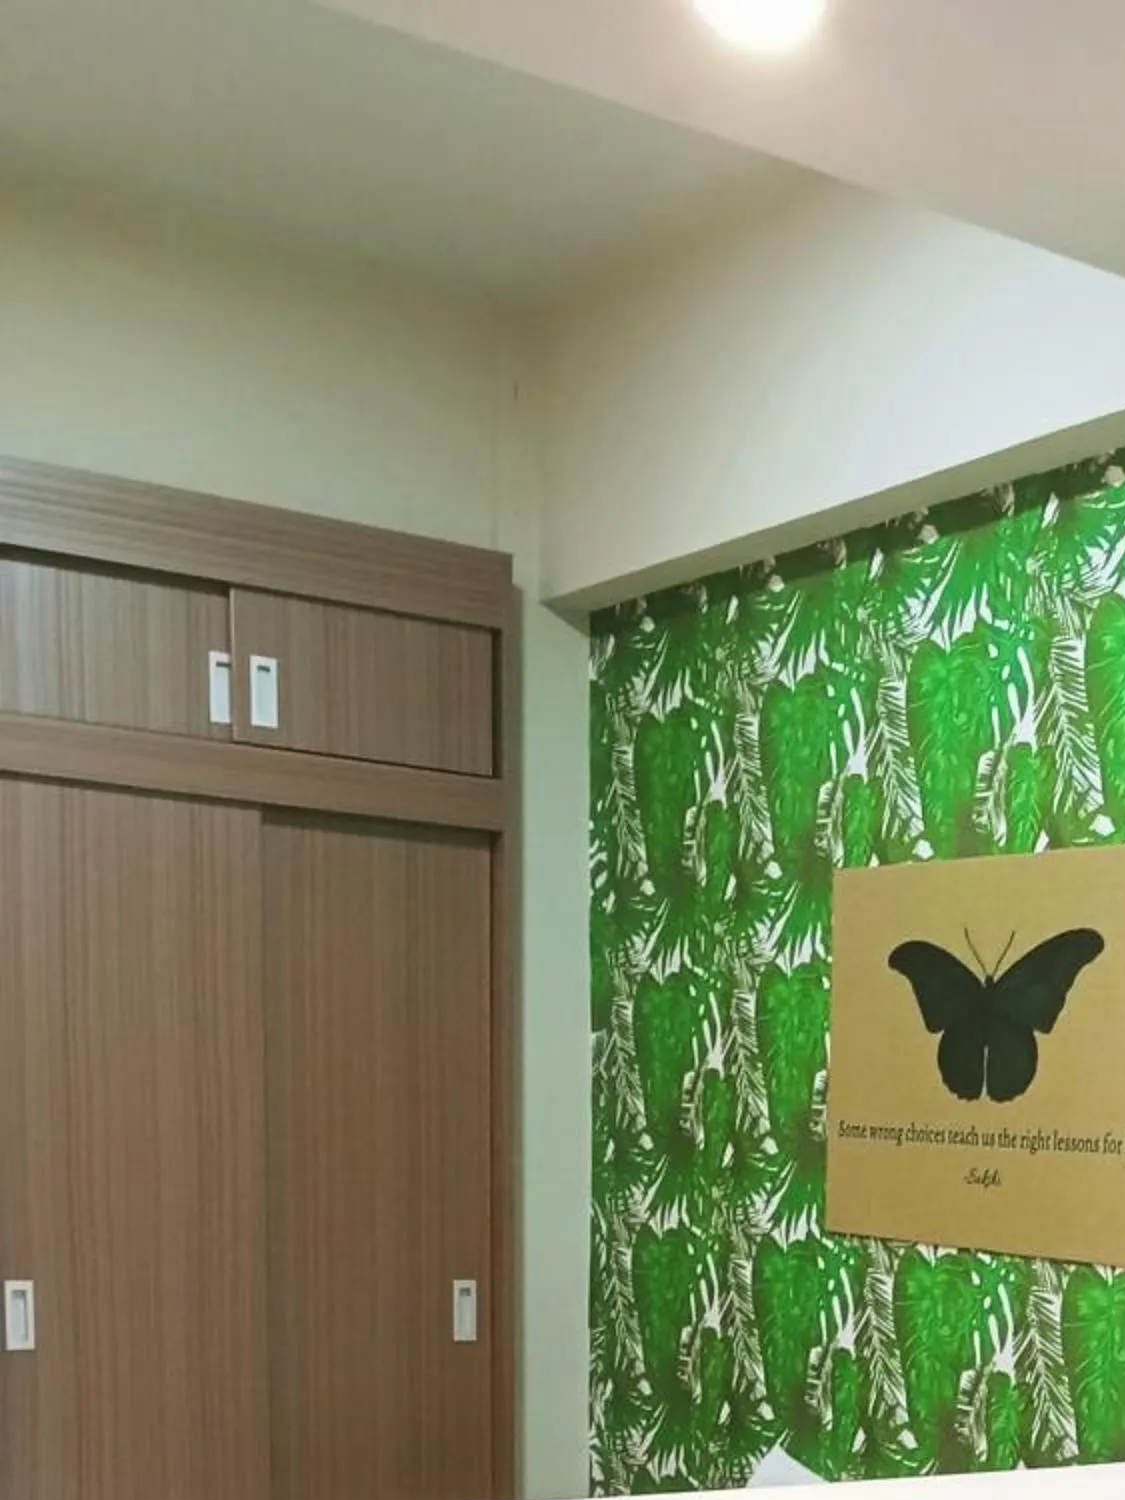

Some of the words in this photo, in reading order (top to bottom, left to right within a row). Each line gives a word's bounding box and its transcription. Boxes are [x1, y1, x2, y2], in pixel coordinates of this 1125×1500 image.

[839, 1119, 867, 1139] Some
[869, 1125, 904, 1147] wrong
[905, 1120, 945, 1144] choices
[947, 1124, 979, 1146] teach
[981, 1131, 995, 1147] us
[997, 1127, 1017, 1149] the
[1019, 1127, 1051, 1156] right
[1053, 1127, 1100, 1153] lessons
[1102, 1131, 1123, 1154] for
